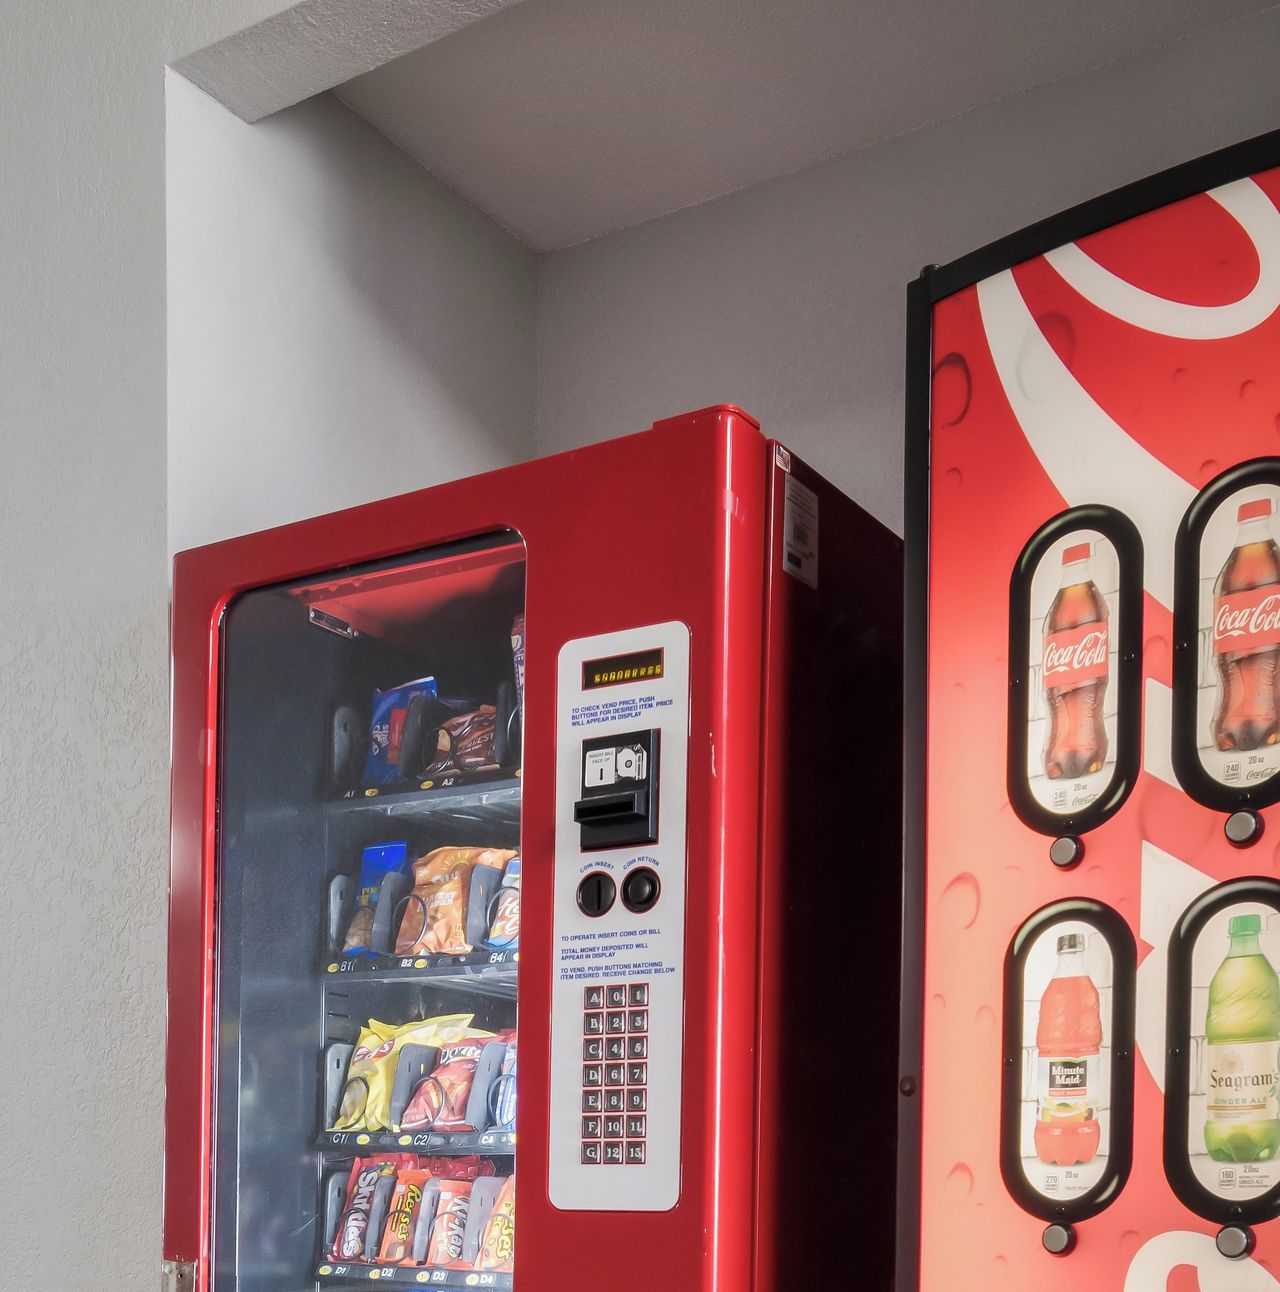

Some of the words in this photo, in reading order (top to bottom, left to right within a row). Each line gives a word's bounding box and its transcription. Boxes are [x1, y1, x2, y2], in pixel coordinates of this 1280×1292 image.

[1044, 631, 1107, 675] Coca-Cola
[572, 711, 598, 721] BUTTONS
[613, 705, 638, 714] DESIRED
[656, 699, 674, 707] PRICE
[581, 705, 600, 713] CHECK
[586, 716, 609, 725] APPEAR
[618, 711, 642, 720] DISPLAY
[1248, 756, 1257, 765] 20
[1225, 763, 1240, 773] 240
[442, 778, 455, 786] A2
[580, 862, 594, 874] COIN
[594, 861, 614, 870] INSERT
[623, 858, 637, 870] COIN
[638, 856, 660, 866] RETURN
[570, 933, 596, 941] OPERATE
[597, 931, 618, 939] INSERT
[561, 947, 579, 955] TOTAL
[580, 945, 600, 953] MONEY
[602, 943, 634, 952] DEPOSITED
[490, 953, 501, 963] B4
[561, 953, 584, 961] APPEAR
[401, 959, 413, 967] B2
[604, 962, 632, 971] BUTTONS
[632, 961, 663, 969] MATCHING
[602, 969, 626, 978] RECEIVE
[628, 967, 653, 976] CHANGE
[590, 993, 599, 1003] A
[613, 992, 620, 1001] 0
[636, 991, 641, 1000] 1
[590, 1018, 598, 1028] B
[613, 1018, 620, 1027] 2
[635, 1017, 642, 1026] 3
[589, 1044, 598, 1054] C
[611, 1044, 618, 1053] 4
[634, 1043, 642, 1052] 5
[589, 1070, 597, 1080] D
[611, 1070, 618, 1079] 6
[633, 1069, 640, 1078] 7
[1052, 1065, 1085, 1075] Minute
[1056, 1074, 1080, 1085] Maid
[1210, 1069, 1279, 1091] Seagram's
[588, 1096, 596, 1105] E
[611, 1096, 617, 1105] 8
[633, 1095, 639, 1105] 9
[588, 1122, 596, 1131] F
[608, 1122, 619, 1131] 10
[631, 1122, 641, 1131] 11
[333, 1133, 345, 1143] C1
[414, 1133, 428, 1145] C2
[587, 1148, 595, 1157] G
[607, 1148, 619, 1157] 12
[630, 1148, 641, 1157] 13
[1222, 1171, 1233, 1179] 160
[335, 1266, 346, 1275] D1
[380, 1268, 393, 1277] D2
[432, 1272, 445, 1281] D3
[480, 1275, 493, 1284] D4
